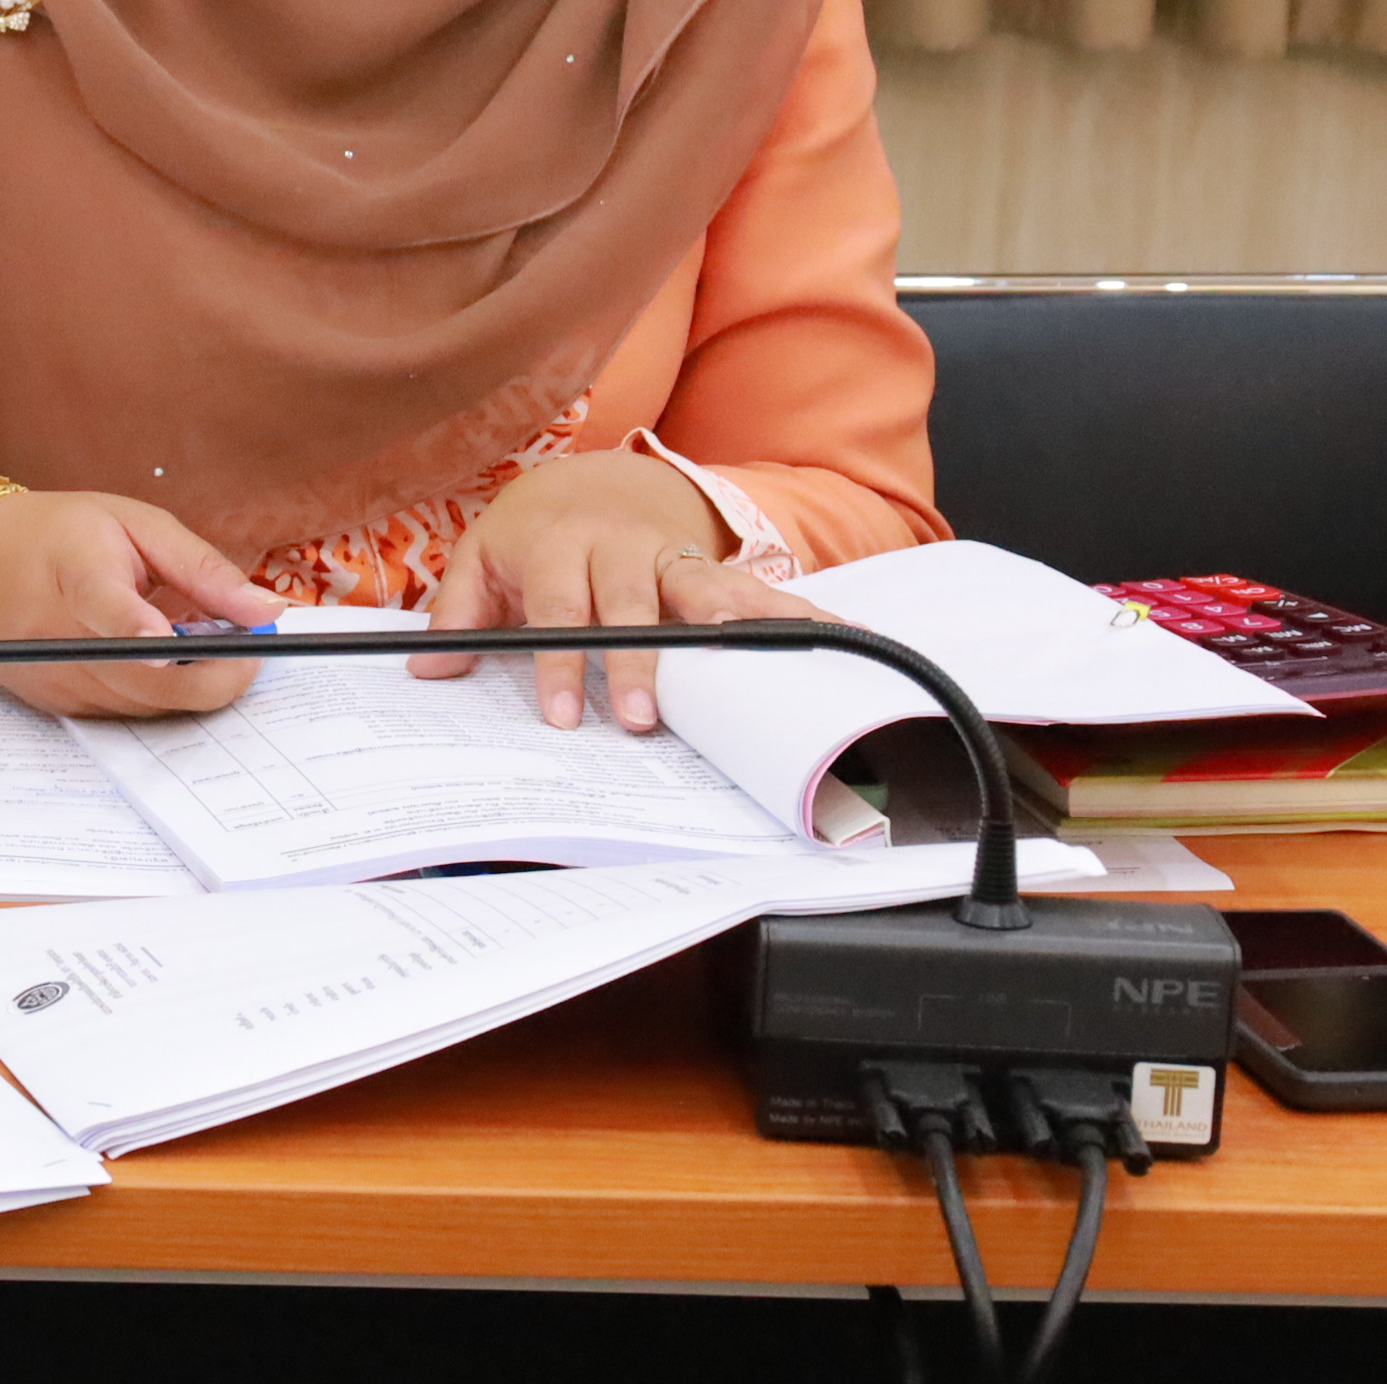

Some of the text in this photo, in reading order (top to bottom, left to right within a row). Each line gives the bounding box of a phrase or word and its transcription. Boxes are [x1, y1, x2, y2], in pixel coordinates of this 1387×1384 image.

[1203, 605, 1222, 613] 4
[1179, 621, 1204, 630] 8
[1242, 616, 1263, 626] 7
[1113, 977, 1221, 1008] NPE
